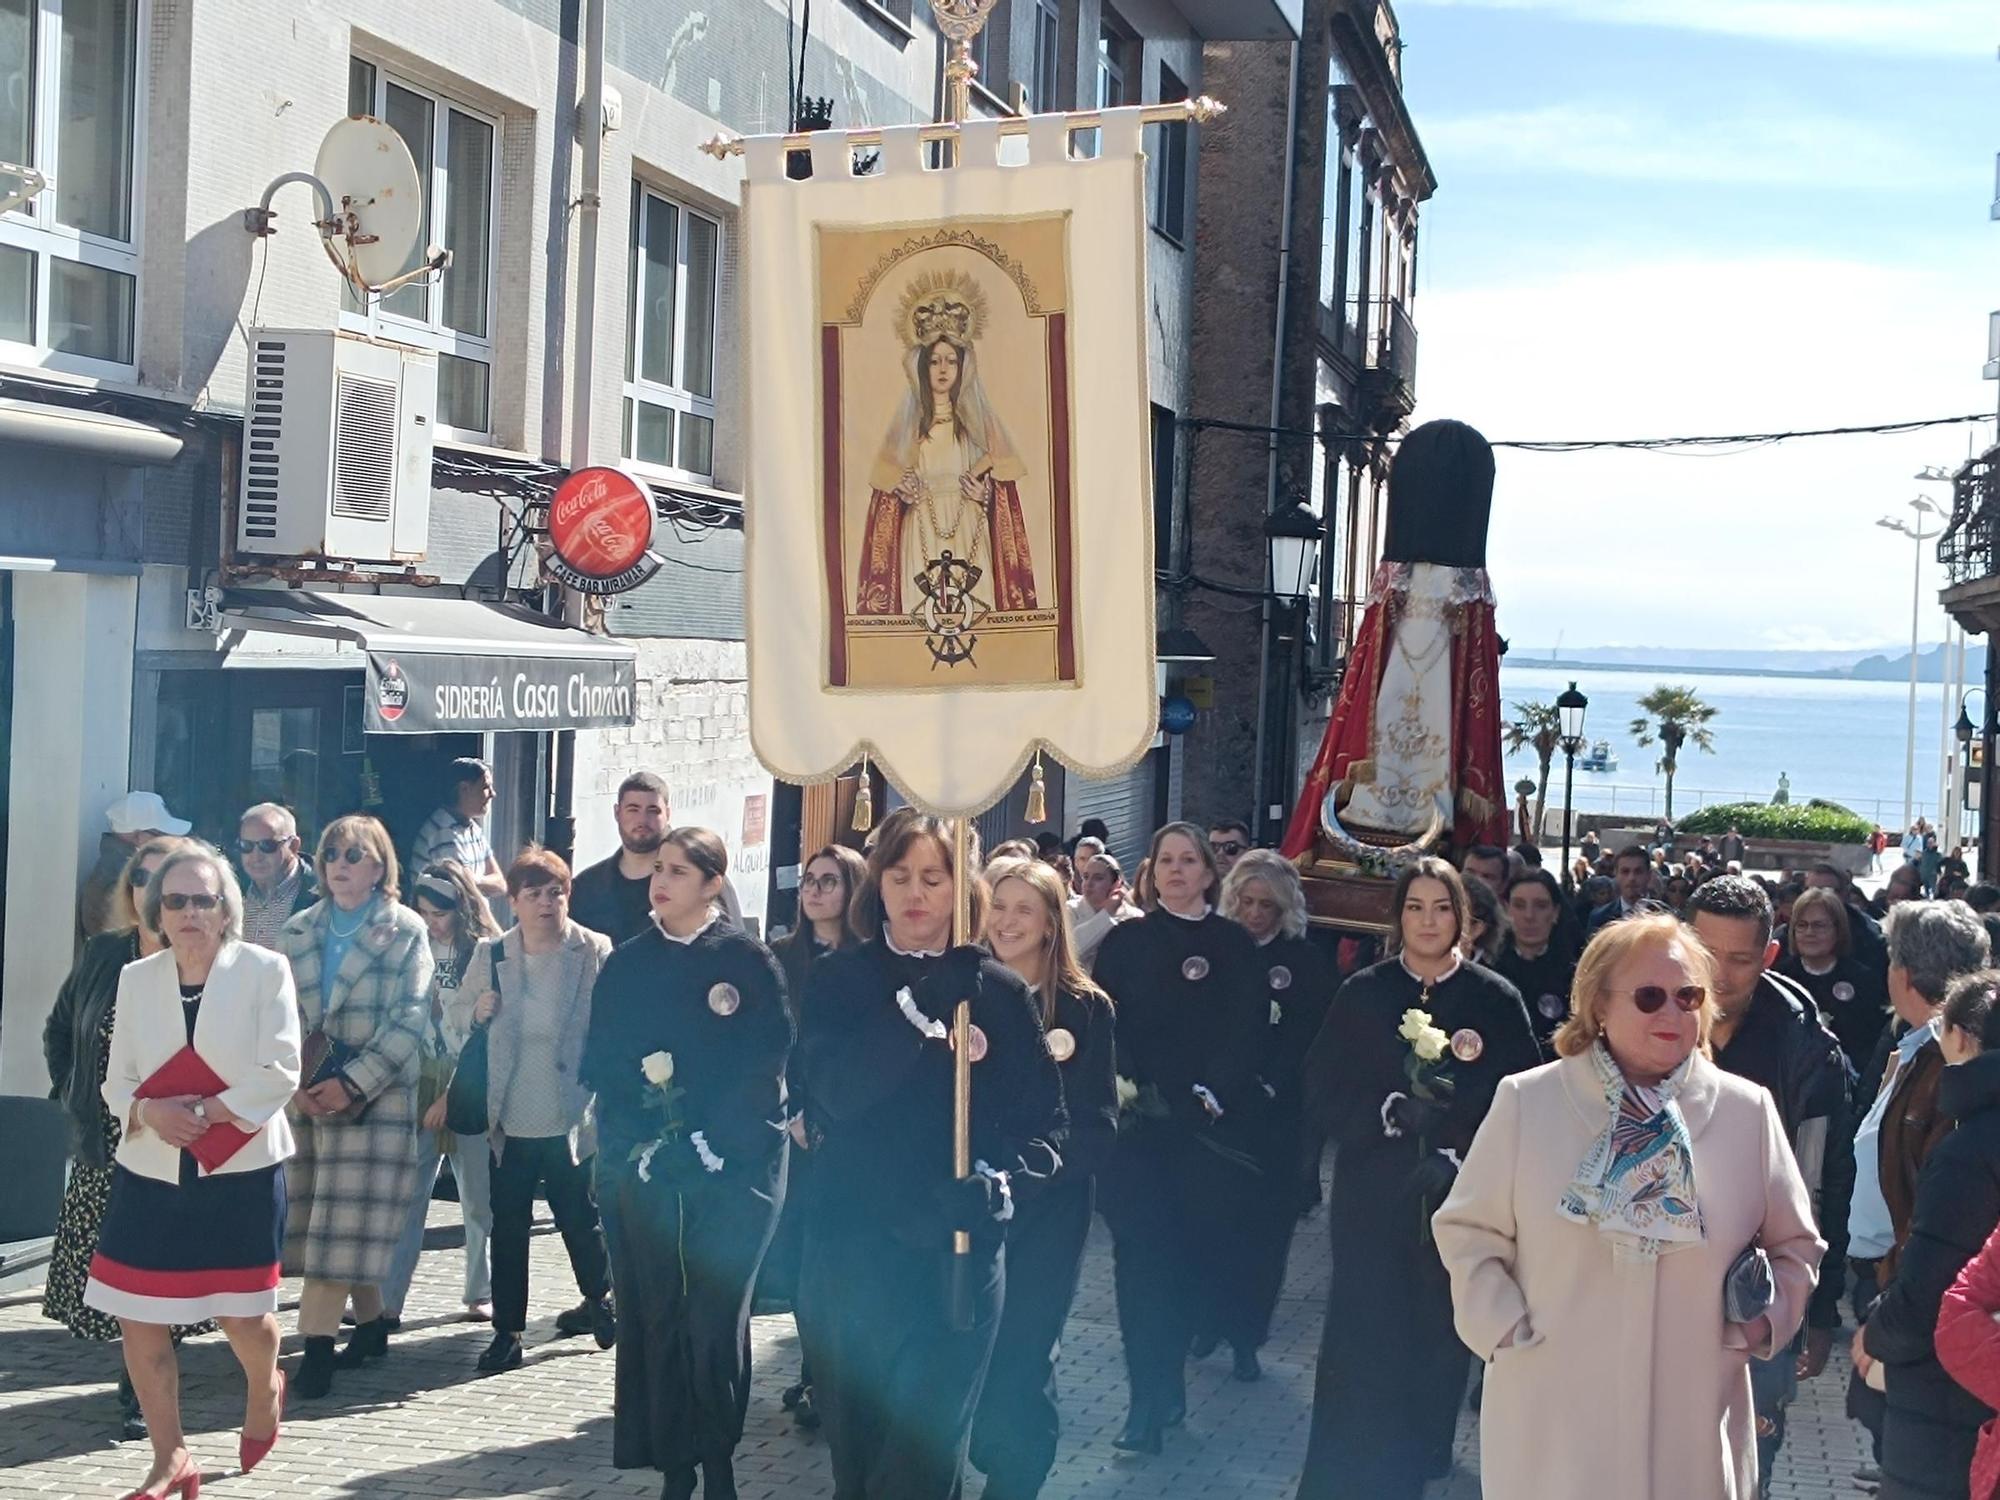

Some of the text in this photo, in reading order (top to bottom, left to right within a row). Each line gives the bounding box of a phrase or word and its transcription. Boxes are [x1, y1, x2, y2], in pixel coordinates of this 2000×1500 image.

[554, 564, 647, 593] CAFE BAR MIRAMAR
[1014, 614, 1025, 622] DE
[435, 676, 505, 719] SIDRERÍA
[513, 673, 559, 718] Casa
